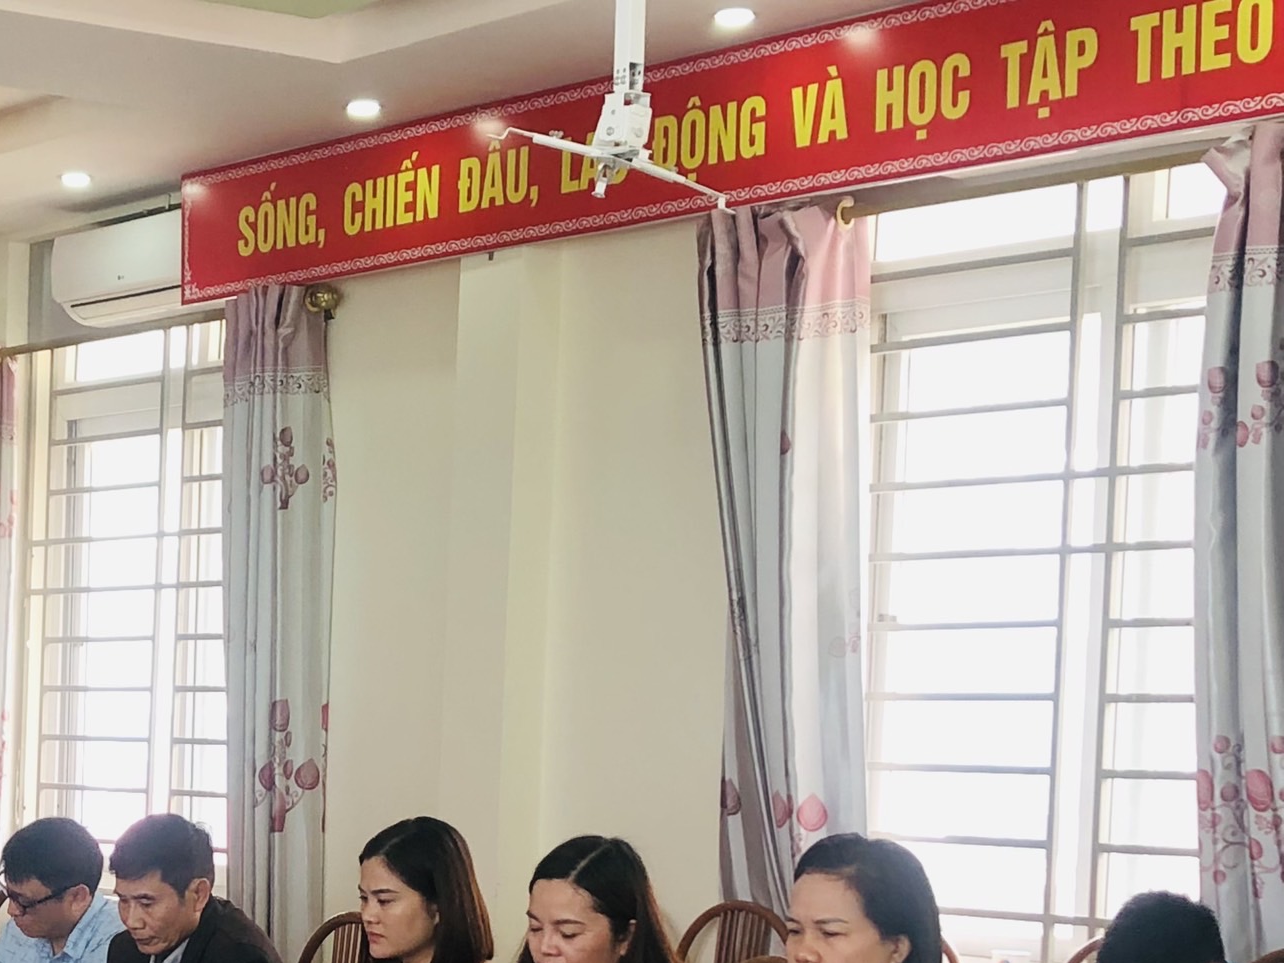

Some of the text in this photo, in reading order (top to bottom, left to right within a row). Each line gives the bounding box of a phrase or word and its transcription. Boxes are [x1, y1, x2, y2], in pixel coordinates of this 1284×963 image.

[238, 182, 326, 257] SỐNG,
[343, 149, 440, 236] CHIẾN
[652, 96, 766, 182] ĐỘNG
[792, 66, 848, 148] VÀ
[875, 52, 971, 140] HỌC
[1000, 19, 1099, 118] TẬP
[1130, 0, 1273, 84] THEO
